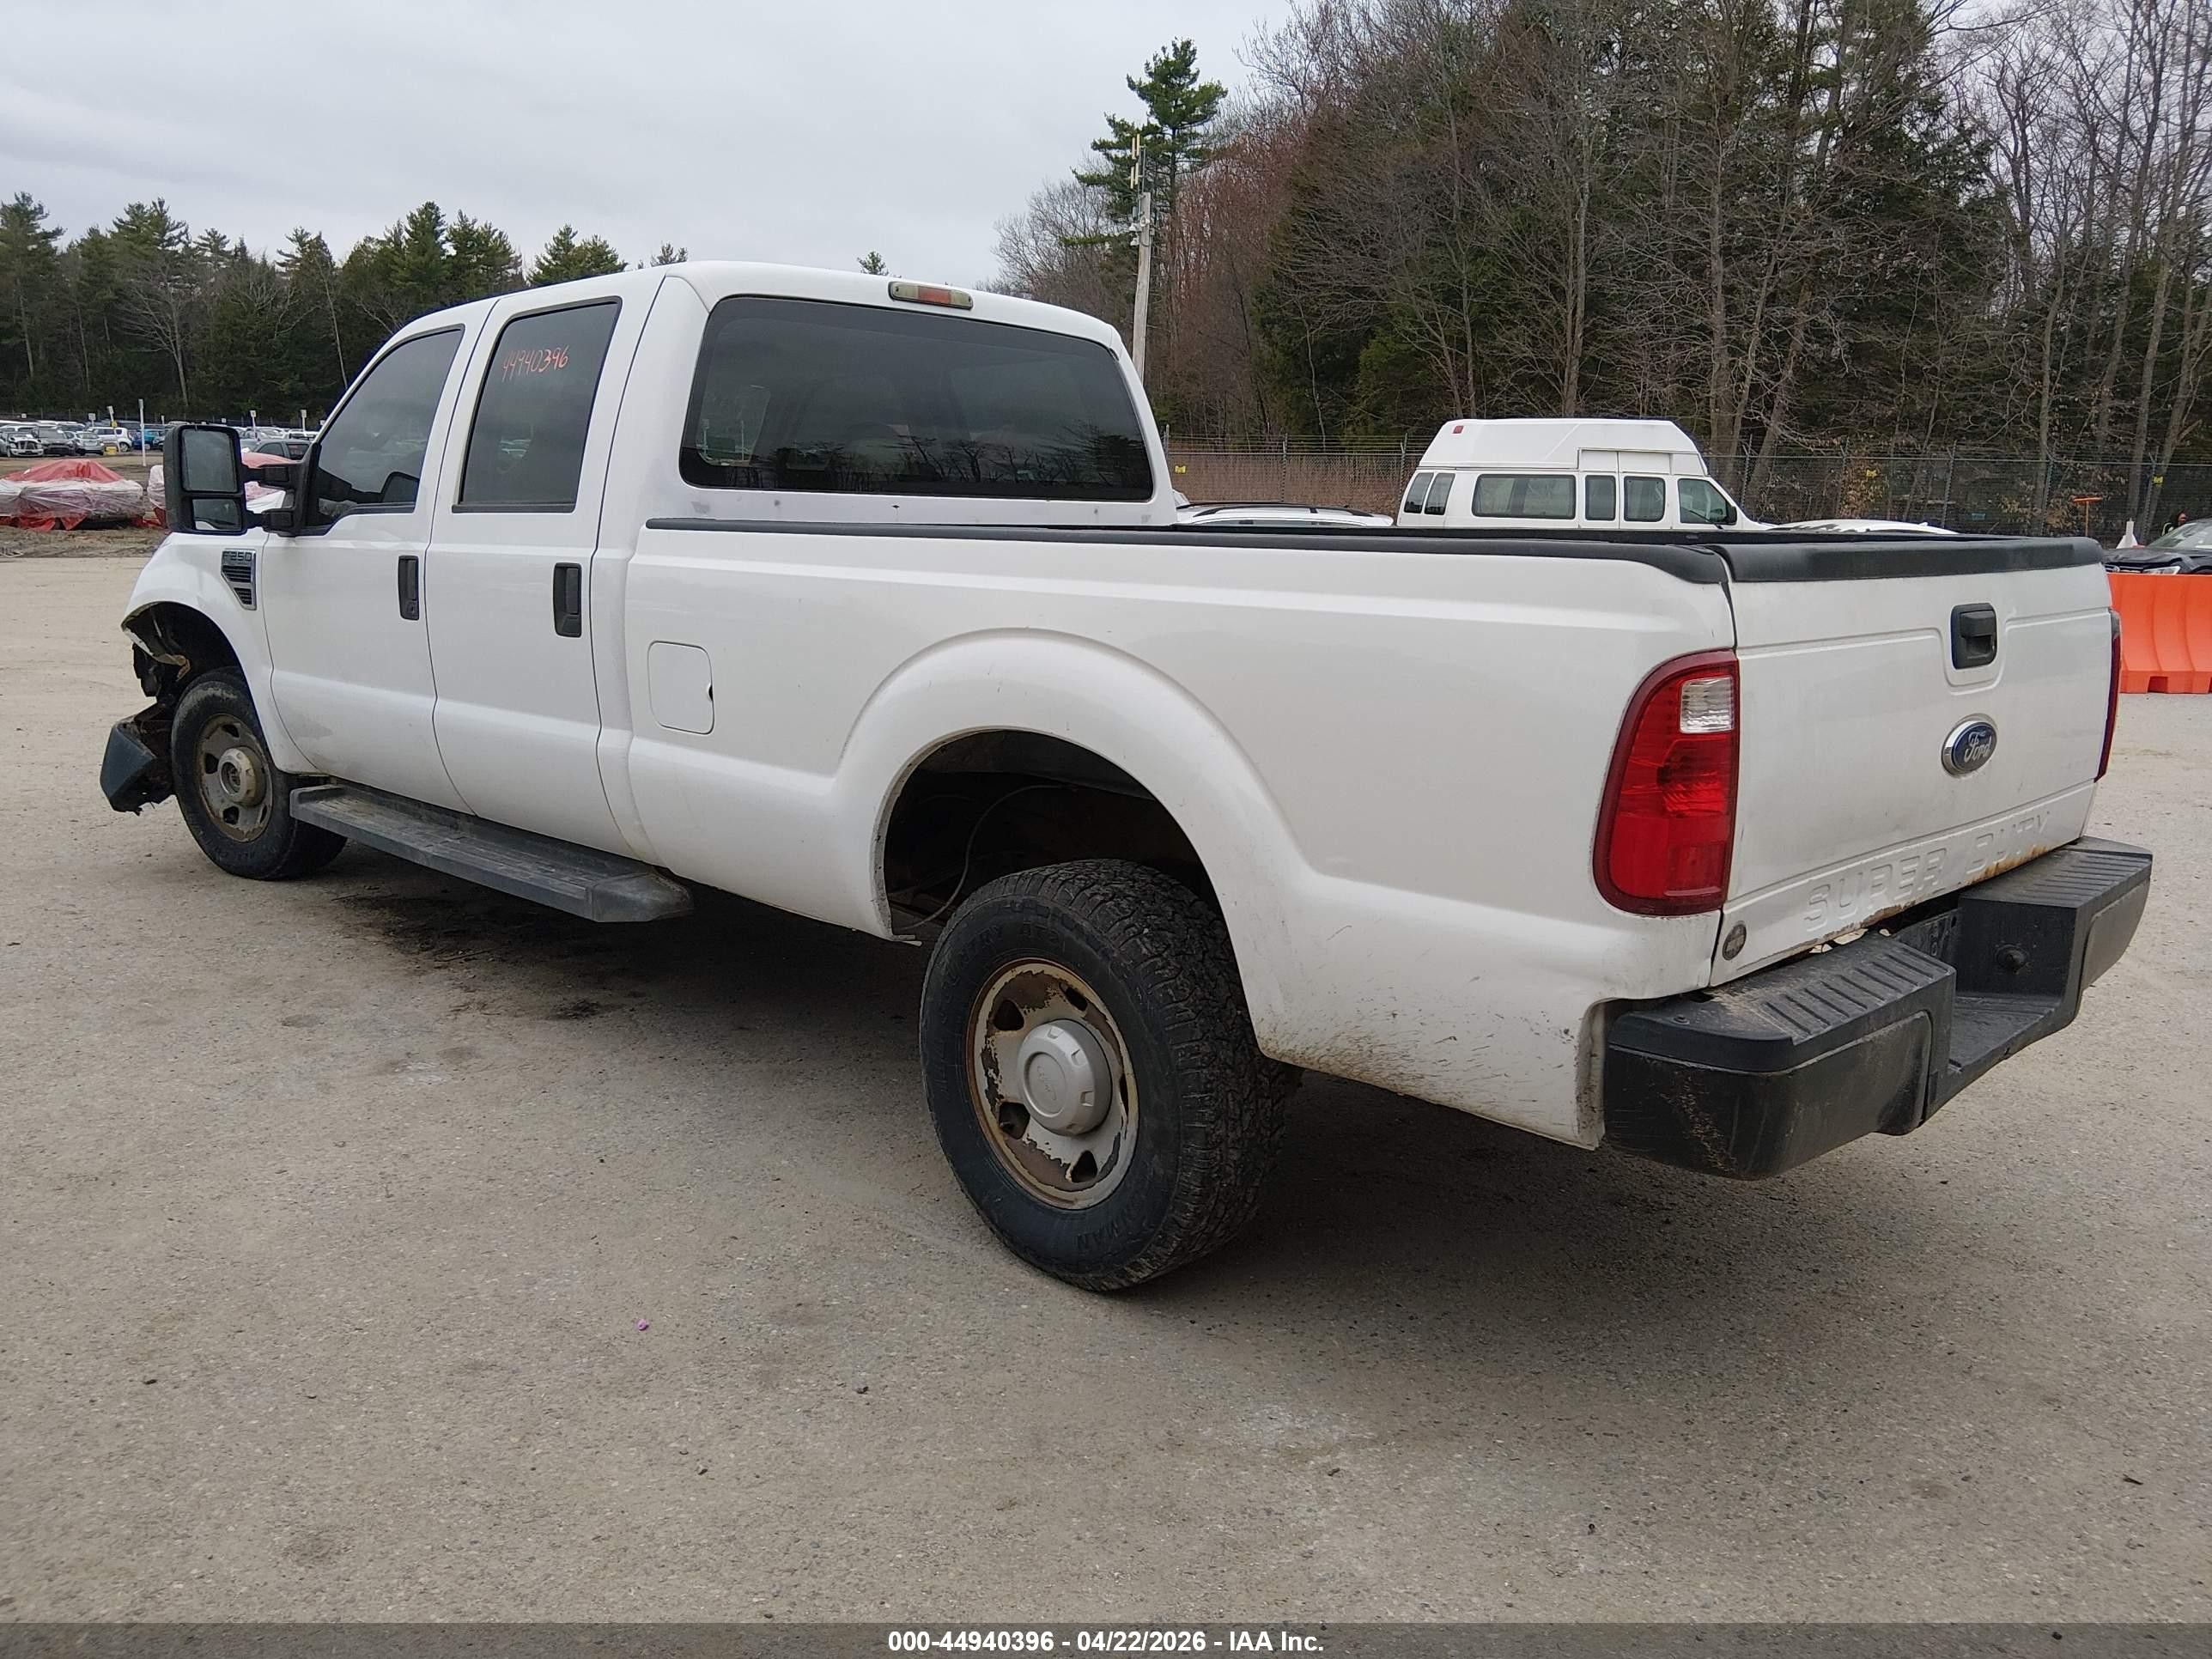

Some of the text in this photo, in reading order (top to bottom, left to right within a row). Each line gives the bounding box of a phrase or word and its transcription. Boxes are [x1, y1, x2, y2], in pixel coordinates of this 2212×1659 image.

[501, 344, 569, 383] 44940396
[1963, 730, 1993, 763] Ford
[1803, 847, 1948, 933] SUPER
